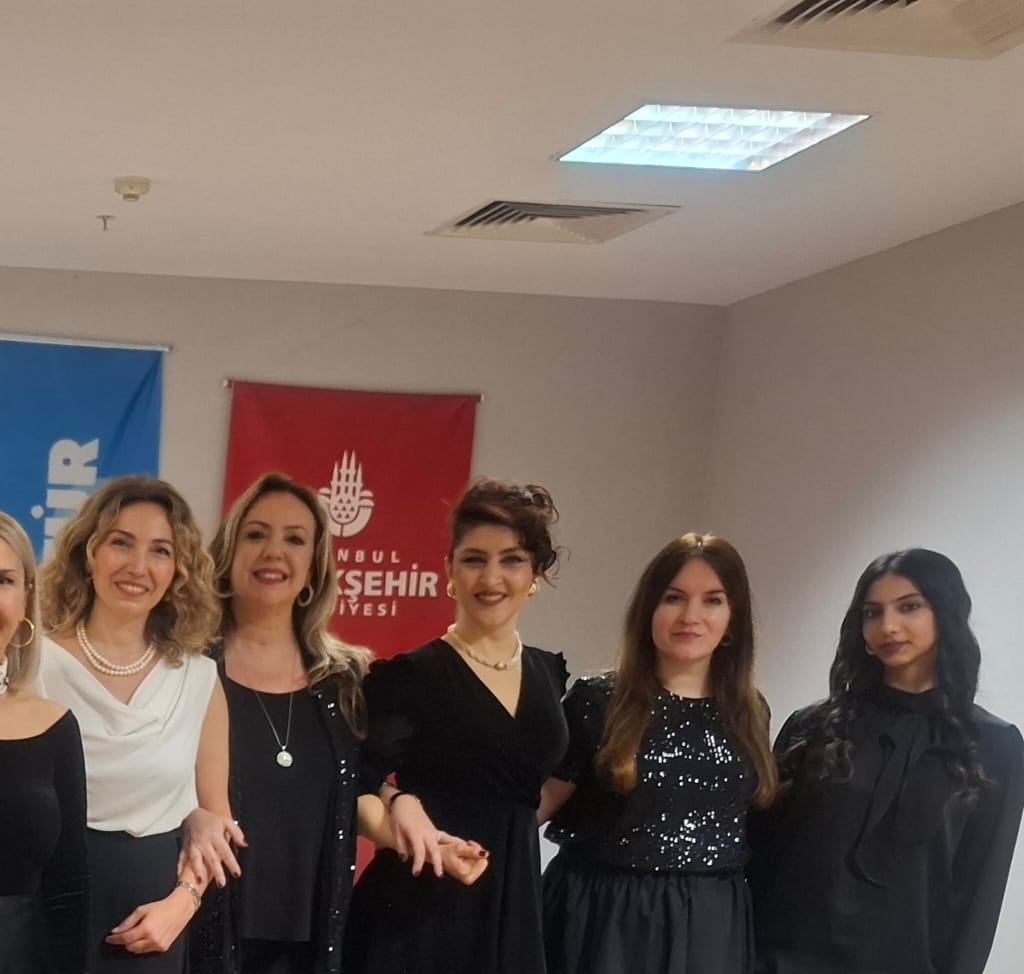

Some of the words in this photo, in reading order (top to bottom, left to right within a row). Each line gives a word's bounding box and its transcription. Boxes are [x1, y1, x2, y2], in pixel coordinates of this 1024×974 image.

[337, 548, 401, 564] NBUL
[335, 563, 439, 603] KŞEHİR
[338, 599, 397, 617] İYESİ
